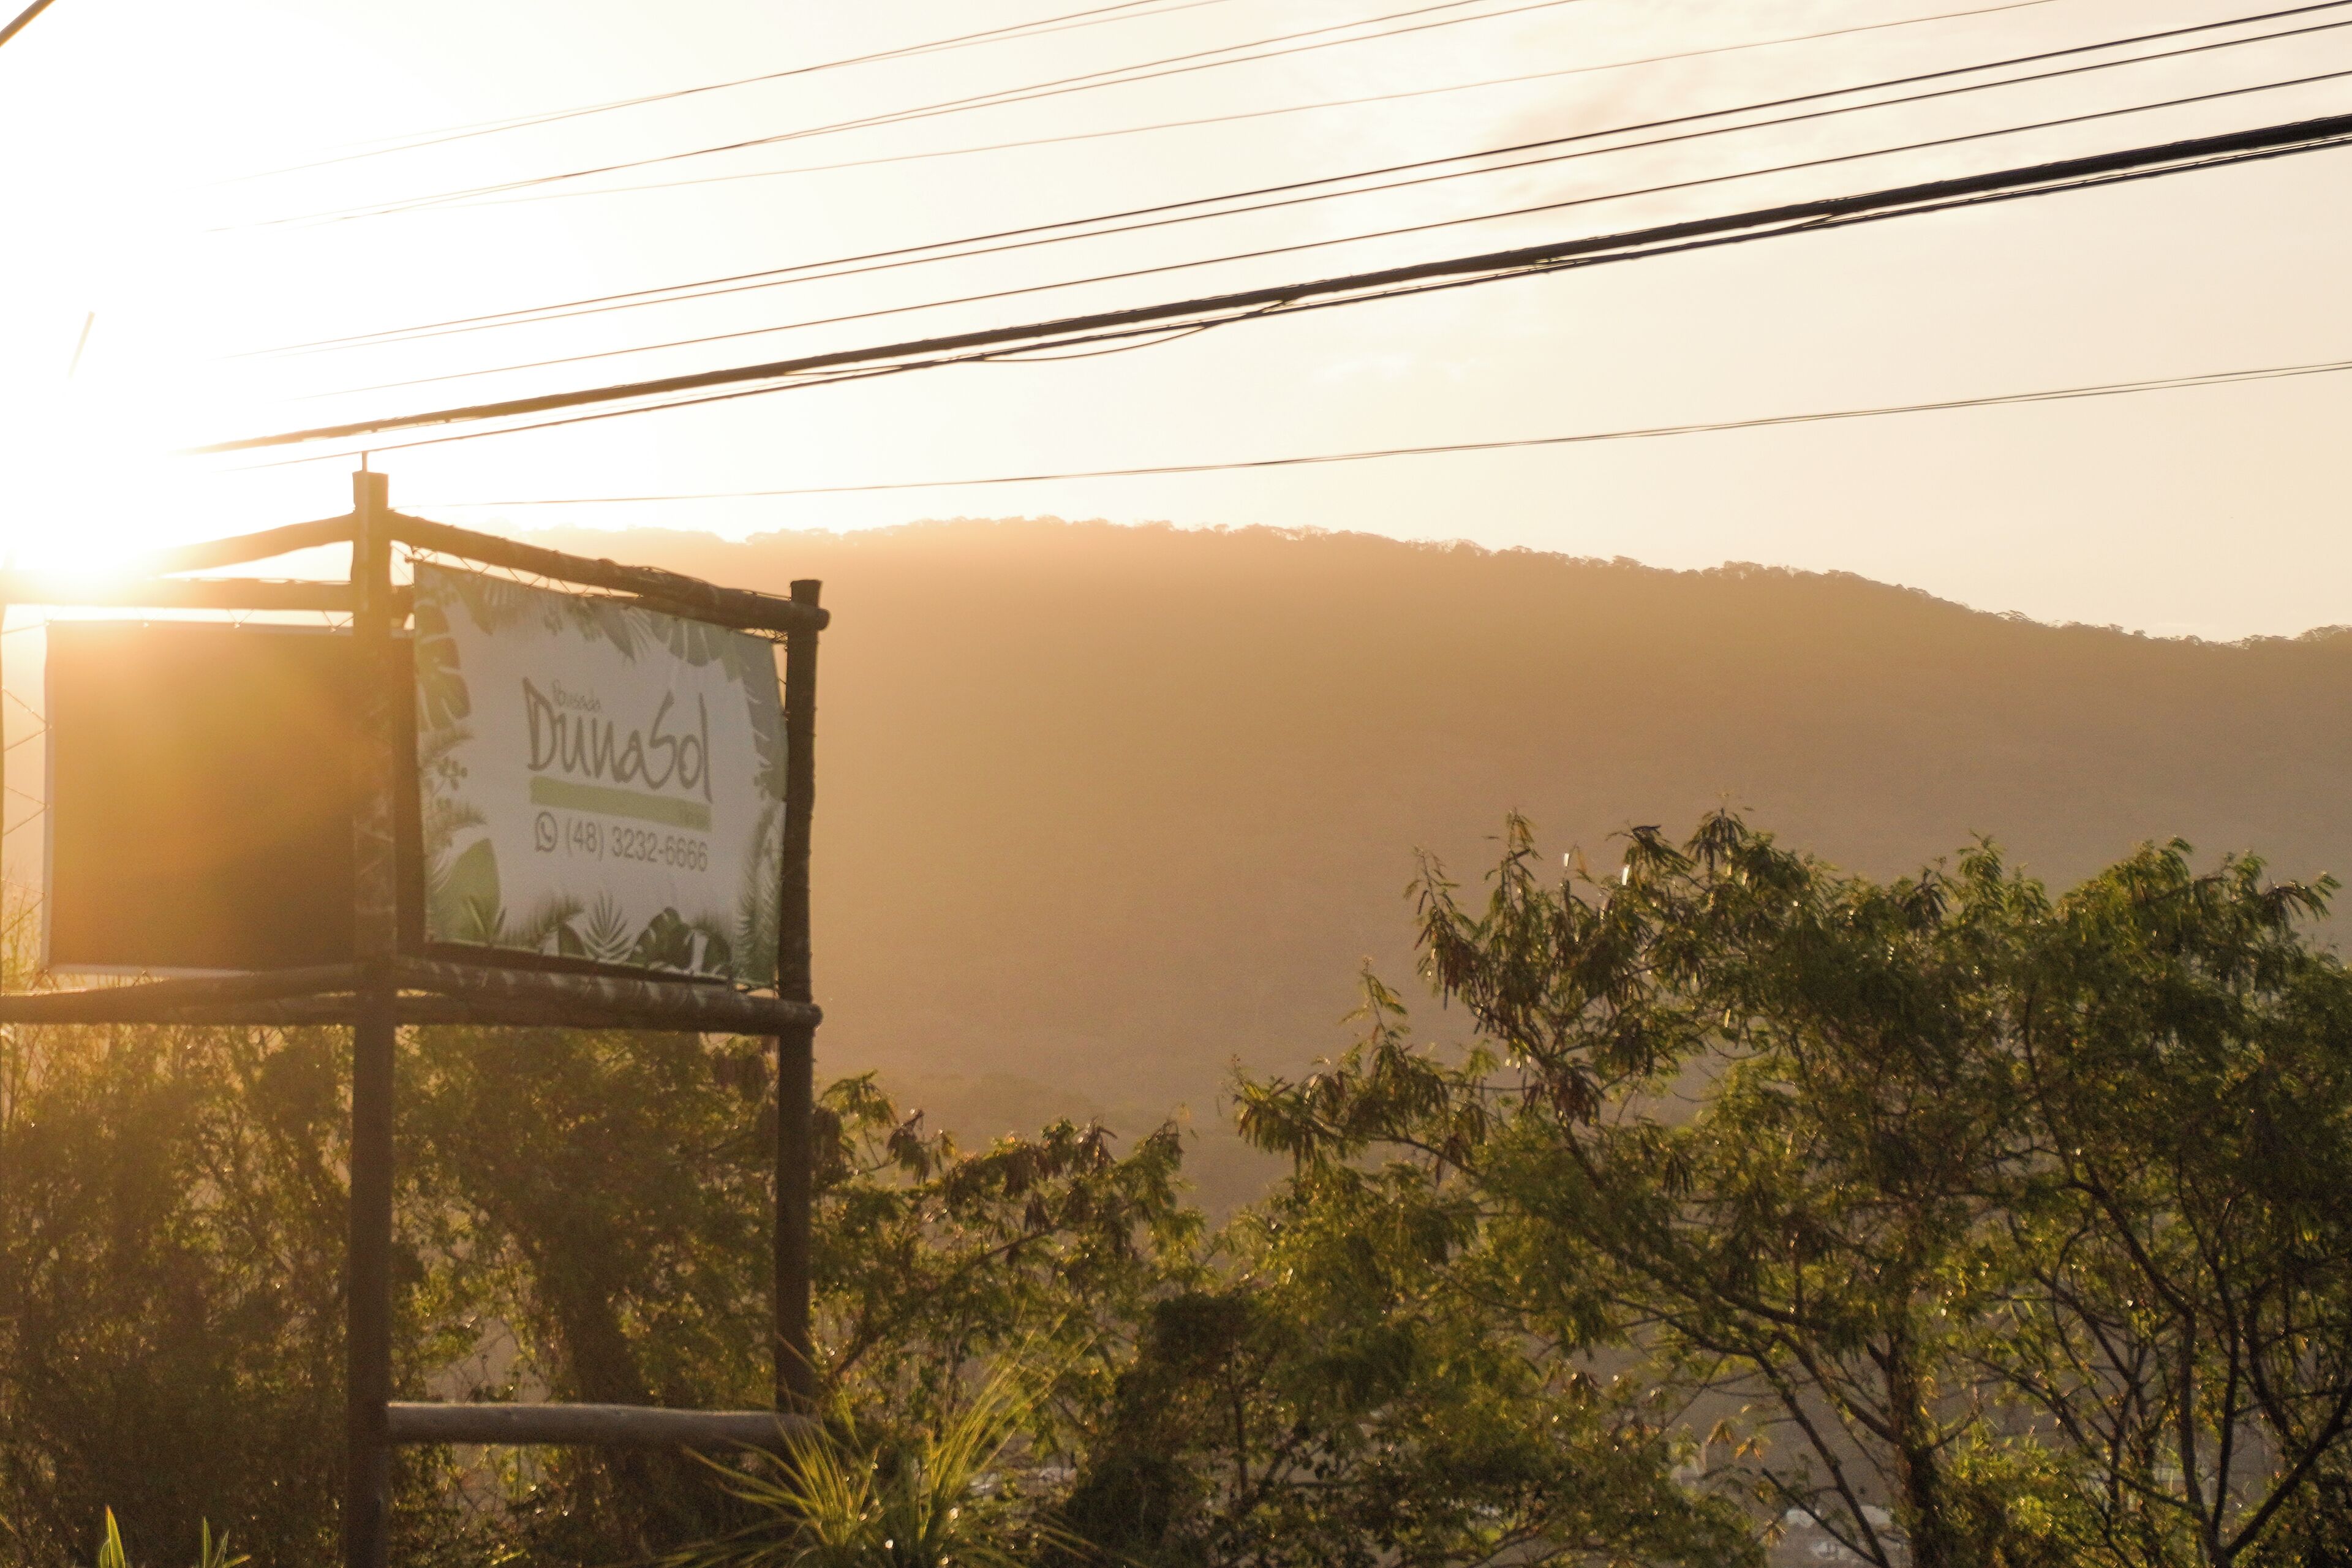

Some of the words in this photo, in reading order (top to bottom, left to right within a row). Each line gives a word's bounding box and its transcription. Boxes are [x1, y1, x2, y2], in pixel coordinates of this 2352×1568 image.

[523, 677, 712, 803] DunaSol
[566, 817, 604, 862] (48)
[612, 826, 708, 872] 3232-6666
